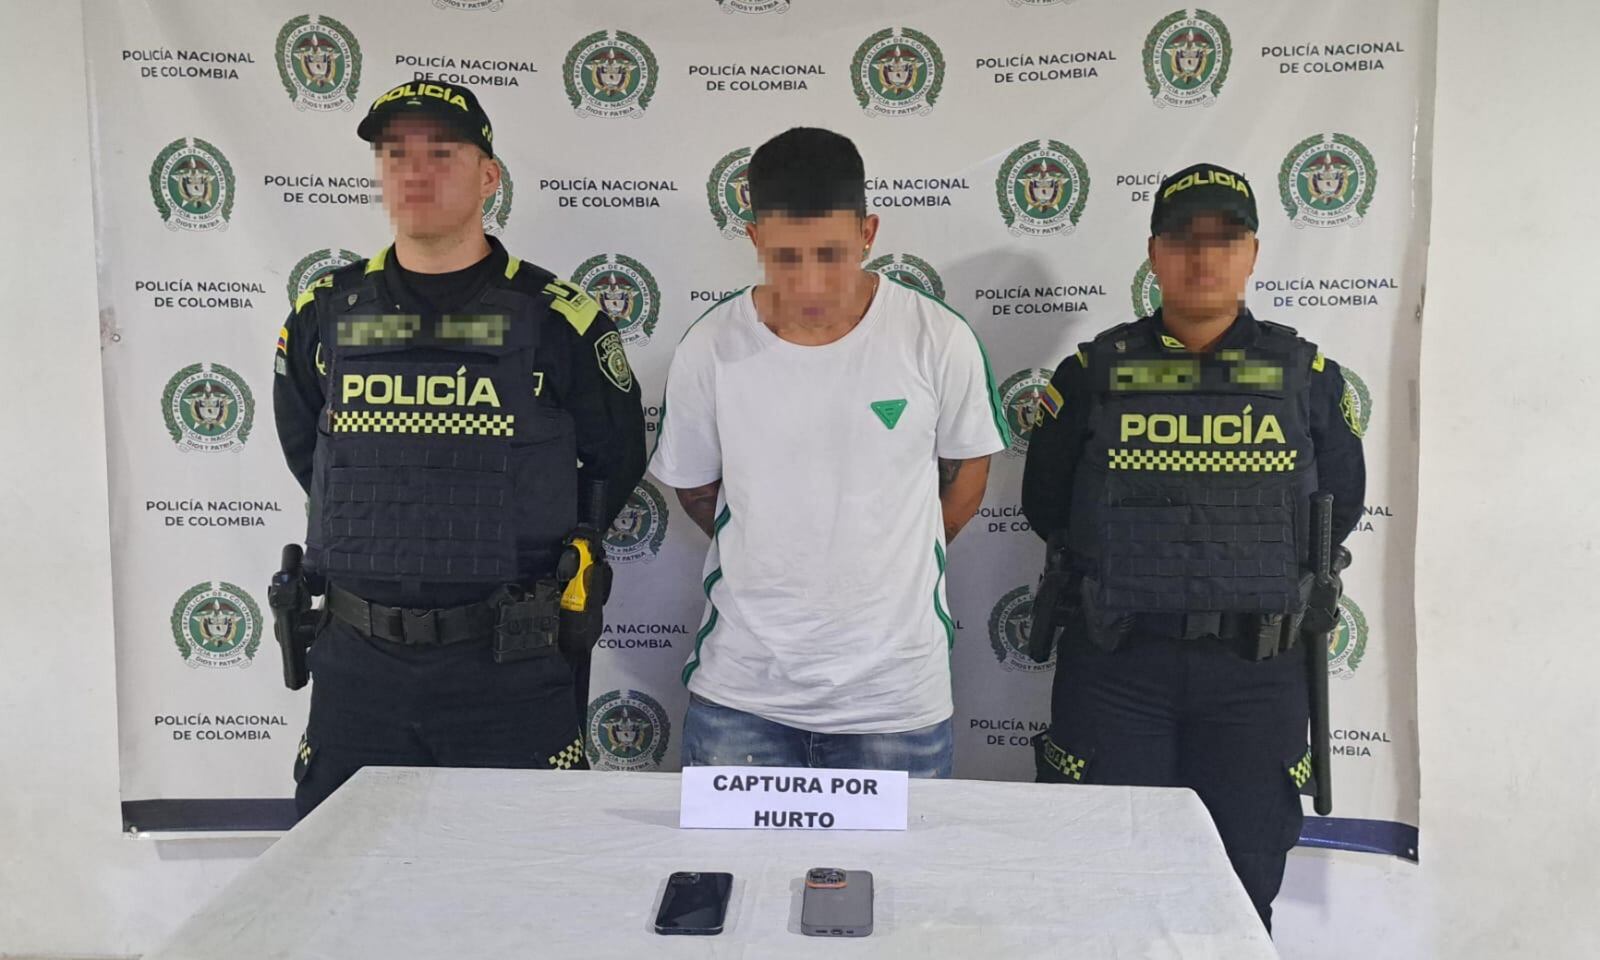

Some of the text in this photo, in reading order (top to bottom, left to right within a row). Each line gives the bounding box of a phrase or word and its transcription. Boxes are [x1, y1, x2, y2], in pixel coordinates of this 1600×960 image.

[122, 46, 255, 64] POLICÍA NACIONAL
[1261, 41, 1405, 58] POLICÍA NACIONAL
[395, 54, 538, 73] POLICÍA NACIONAL
[975, 50, 1117, 69] POLICÍA NACIONAL
[1279, 59, 1385, 74] DE COLOMBIA
[140, 66, 239, 80] DE COLOMBIA
[688, 62, 826, 76] POLICÍA NACIONAL
[994, 66, 1099, 84] DE COLOMBIA
[413, 71, 520, 88] DE COLOMBIA
[706, 79, 808, 92] DE COLOMBIA
[264, 172, 372, 189] POLICÍA NACIO
[539, 176, 679, 191] POLICÍA NACIONAL
[892, 178, 970, 190] NACIONAL
[283, 192, 372, 205] DE COLOMB
[558, 196, 661, 208] DE COLOMBIA
[872, 195, 952, 208] COLOMBIA
[1131, 190, 1150, 202] DE
[135, 278, 266, 294] POLICÍA NACIONAL
[1255, 276, 1399, 292] POLICÍA NACIONAL
[690, 288, 735, 302] POLI
[975, 284, 1107, 300] POLICÍA NACIONAL
[154, 296, 254, 309] DE COLOMBIA
[1273, 294, 1379, 308] DE COLOMBIA
[992, 301, 1089, 316] DE COLOMBIA
[342, 364, 501, 408] POLICÍA
[1119, 403, 1287, 445] POLICÍA
[145, 498, 282, 512] POLICÍA NACIONAL
[164, 516, 266, 527] DE COLOMBIA
[988, 522, 1007, 533] DE
[616, 623, 689, 635] NACIONAL
[597, 638, 673, 649] COLOMBIA
[154, 713, 288, 726] POLICÍA NACIONAL
[969, 717, 1025, 731] POLICÍA
[172, 729, 272, 741] DE COLOMBIA
[986, 734, 1006, 746] DE
[1329, 728, 1392, 743] CIONAL
[1329, 744, 1372, 758] MBIA
[712, 774, 878, 796] CAPTURA POR
[753, 810, 835, 829] HURTO
